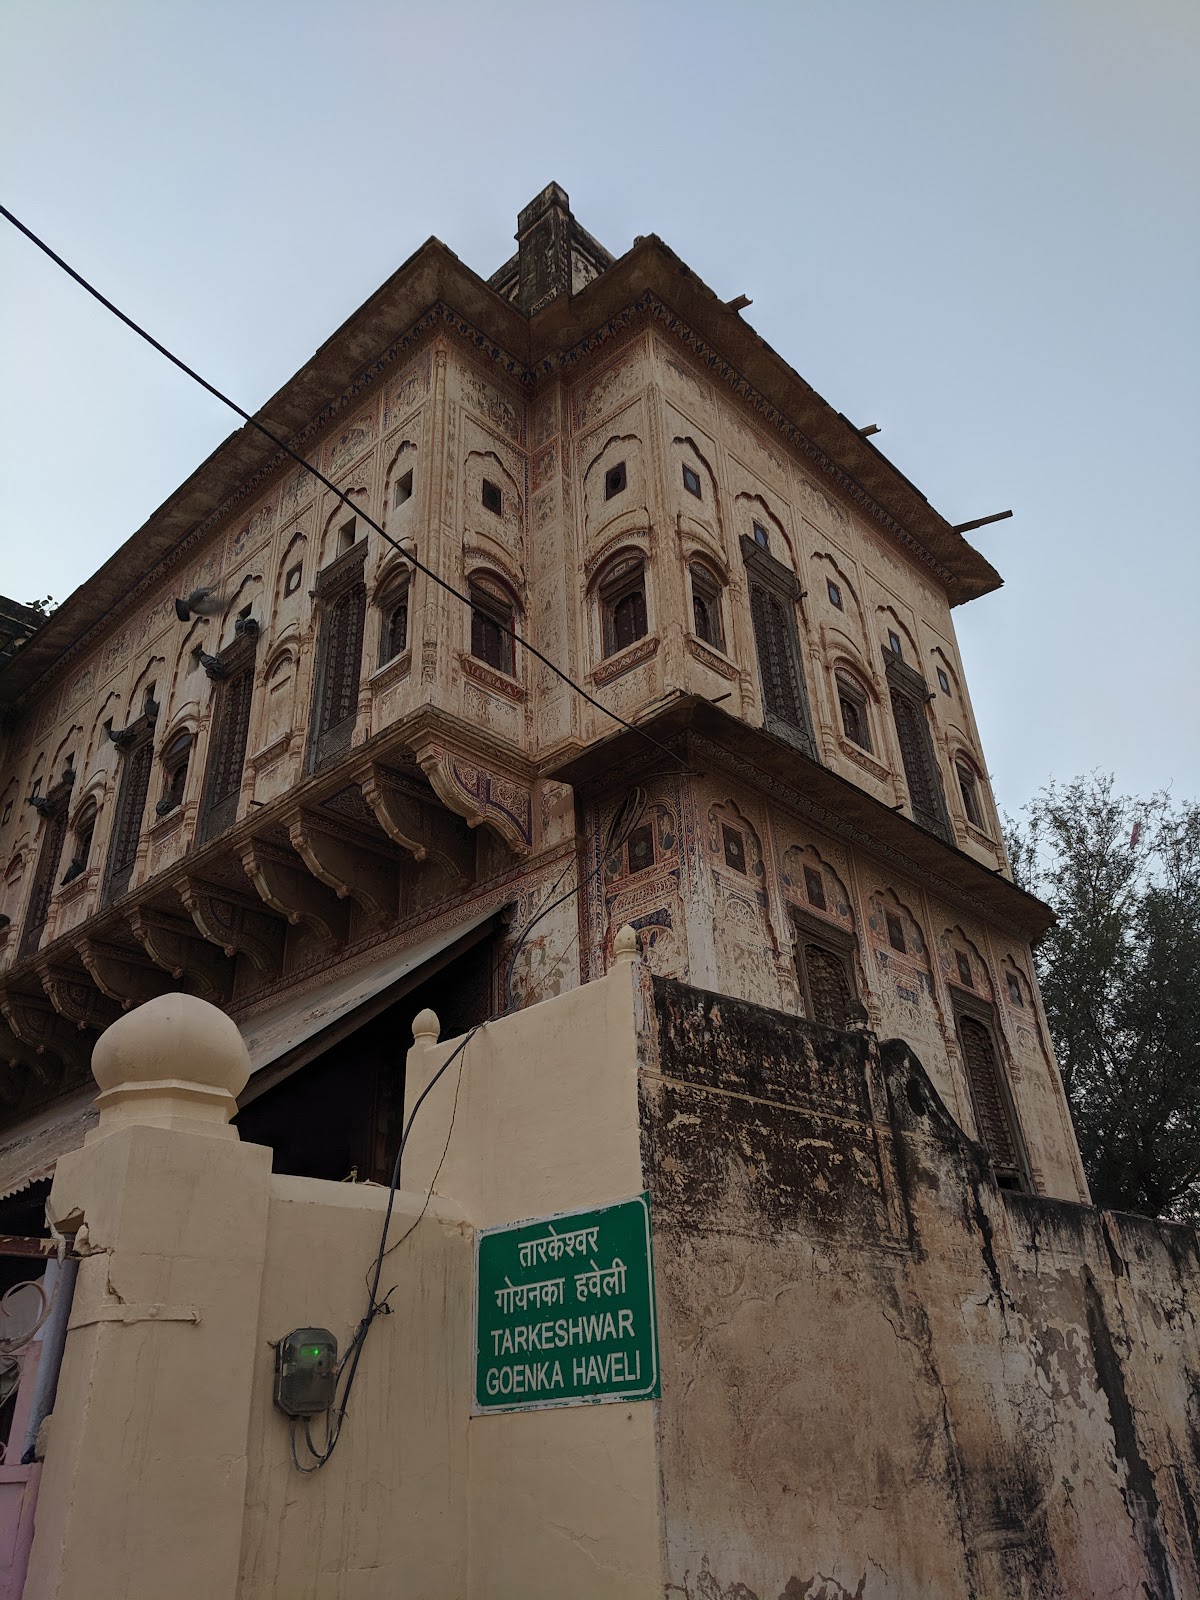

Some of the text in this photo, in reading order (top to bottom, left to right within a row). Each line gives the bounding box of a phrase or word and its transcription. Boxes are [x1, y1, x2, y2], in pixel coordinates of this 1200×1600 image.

[518, 1225, 600, 1268] तारकेश्वर
[495, 1257, 627, 1314] गोयनका हवेली
[491, 1309, 635, 1357] TARKESHWAR
[486, 1350, 641, 1395] GOENKA HAVELI
